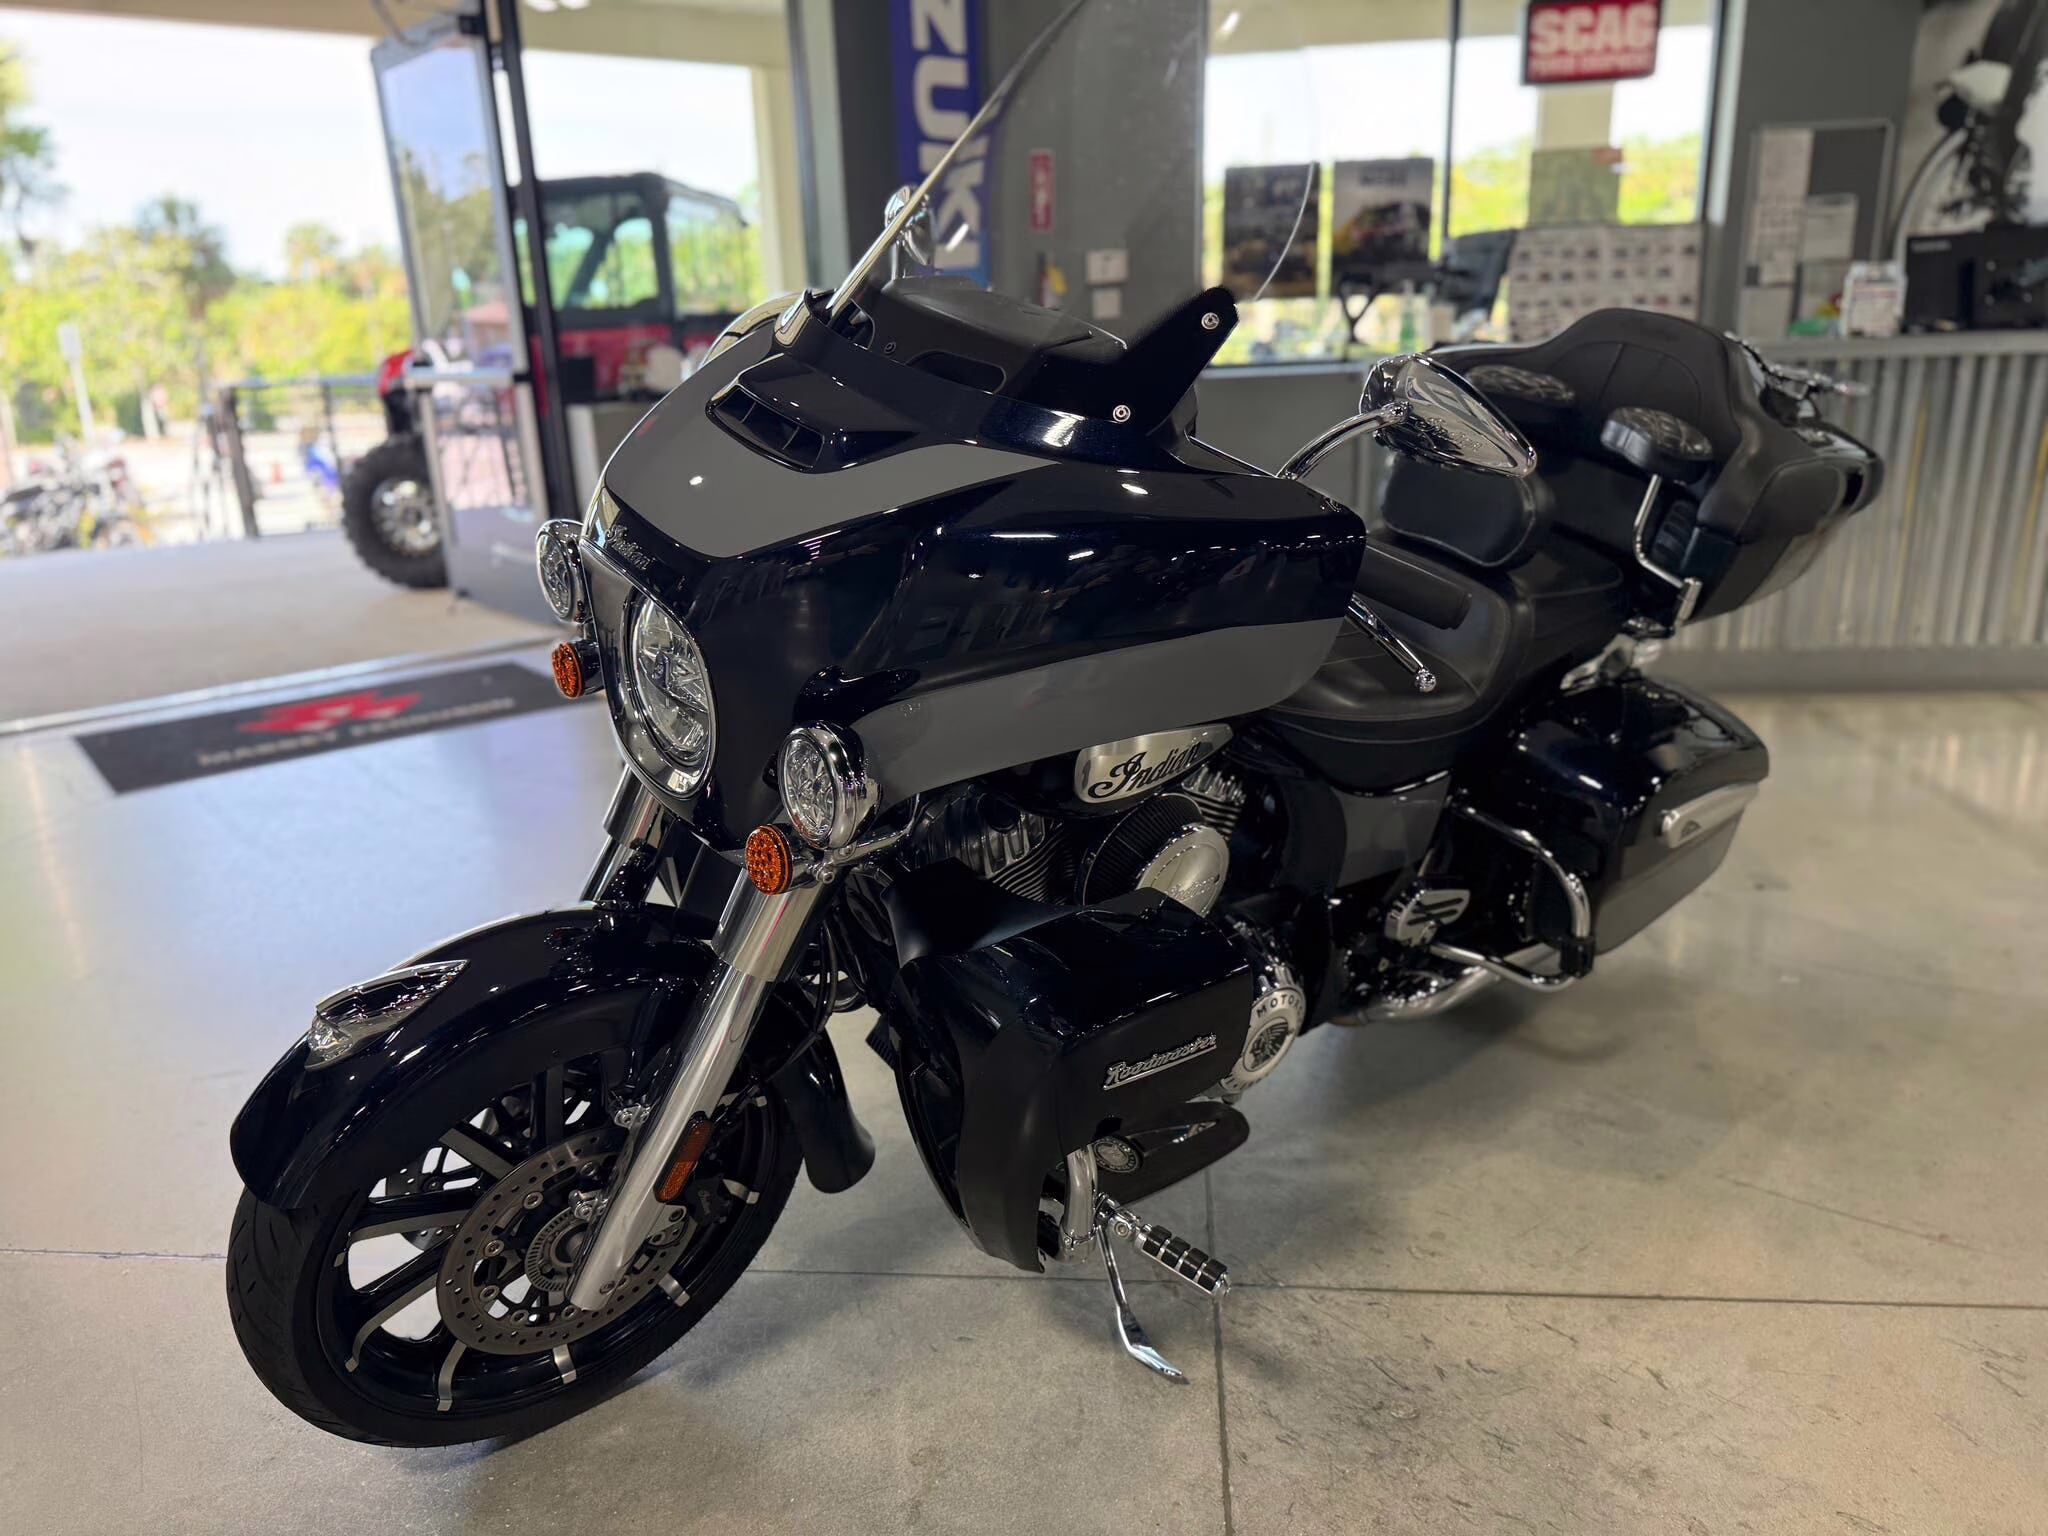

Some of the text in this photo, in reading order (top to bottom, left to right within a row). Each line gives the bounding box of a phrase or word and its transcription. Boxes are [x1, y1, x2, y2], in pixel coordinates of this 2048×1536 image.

[1531, 3, 1657, 54] SCAG
[1087, 743, 1200, 799] Indian
[1104, 1034, 1218, 1090] Roadmaster
